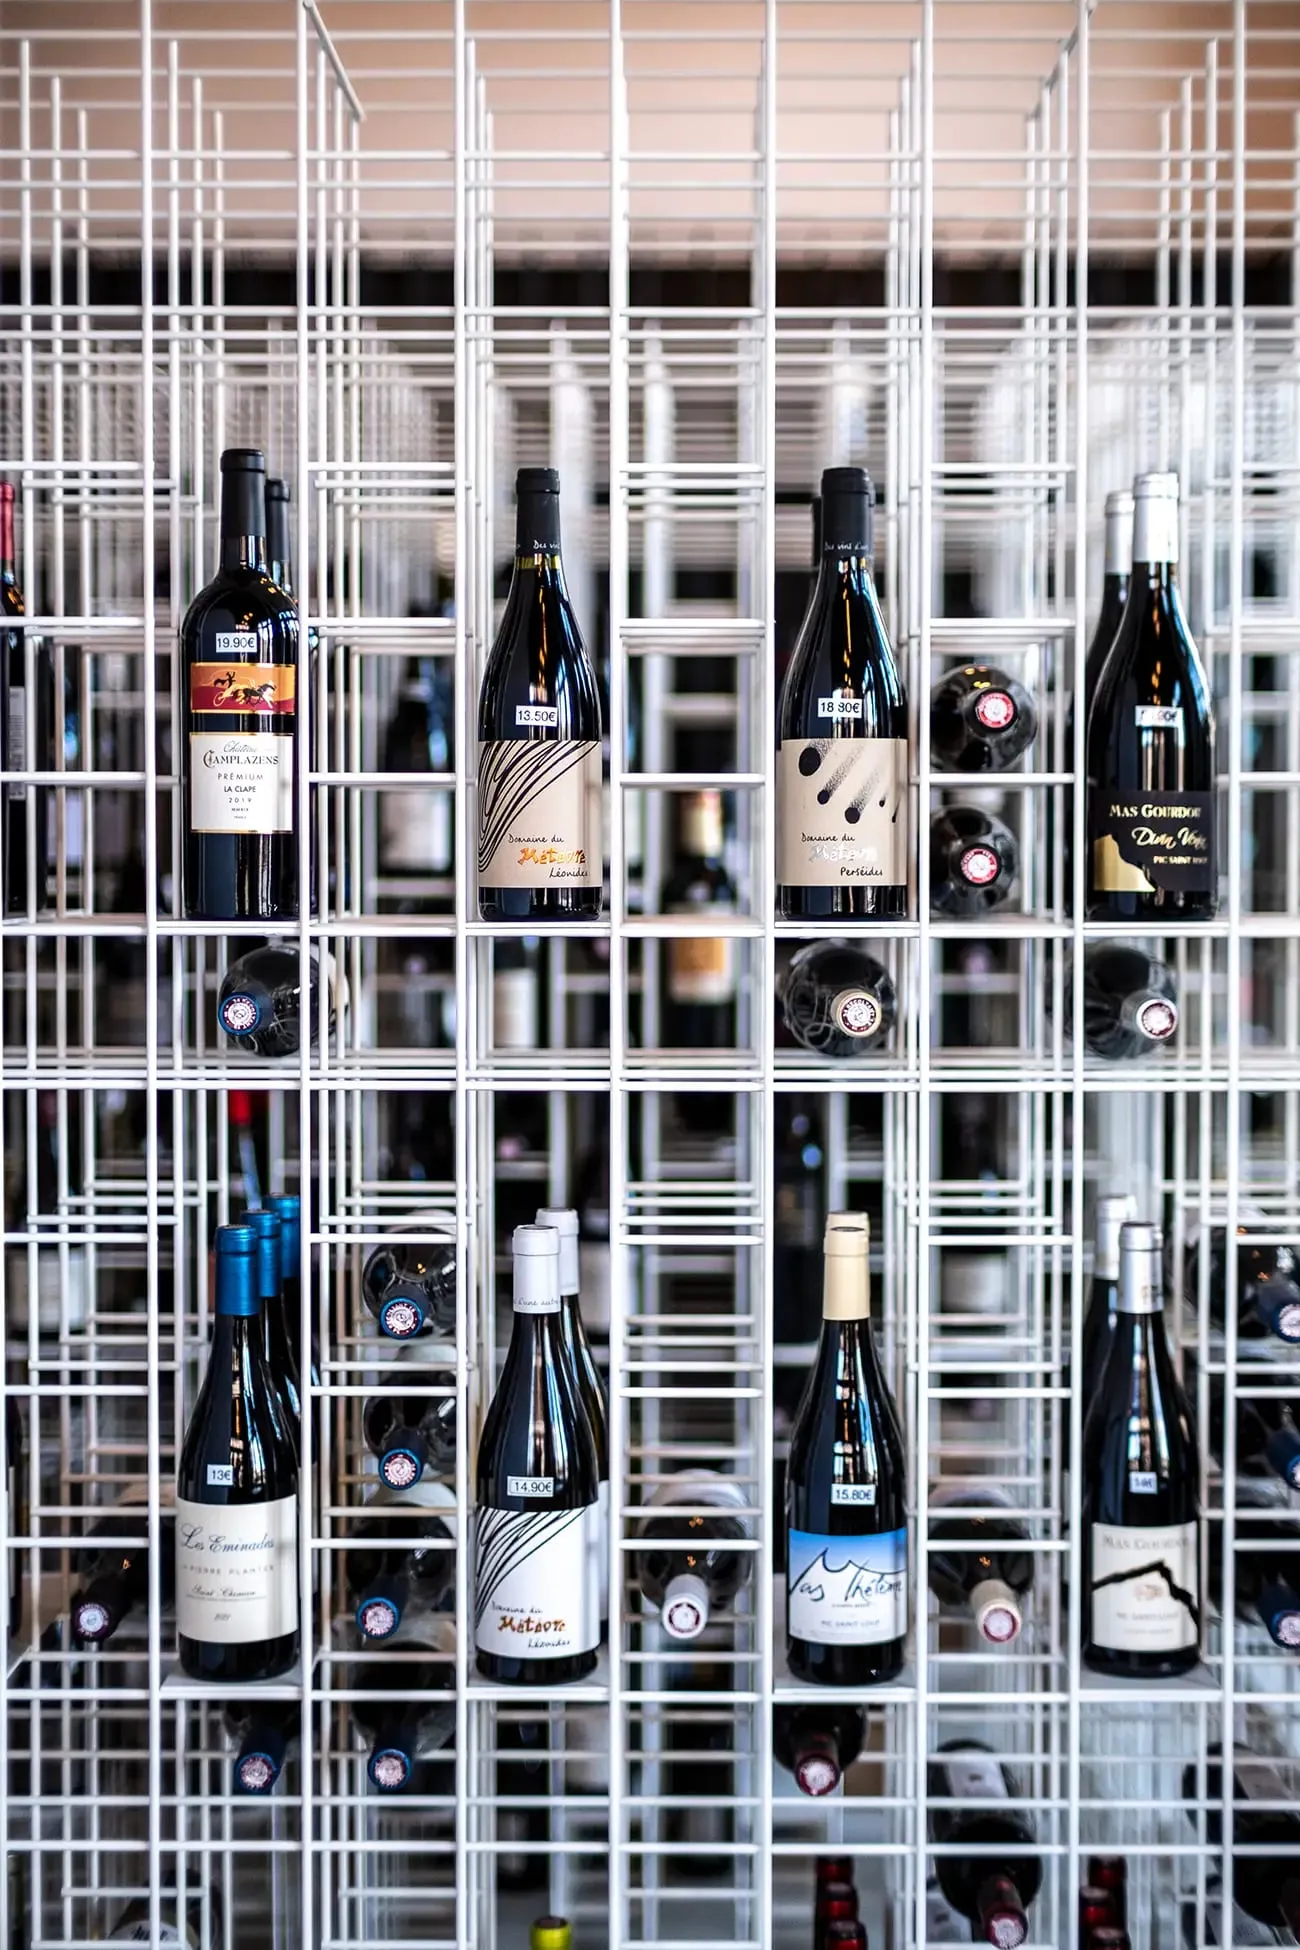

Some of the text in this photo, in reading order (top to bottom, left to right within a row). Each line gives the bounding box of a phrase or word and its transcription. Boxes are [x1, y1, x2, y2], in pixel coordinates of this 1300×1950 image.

[217, 636, 256, 649] 19.90€
[820, 701, 860, 714] 1880€
[518, 709, 557, 723] 13.50€
[223, 785, 256, 793] LA CLAPE
[228, 796, 253, 804] 2019
[1109, 804, 1139, 818] MAS
[508, 833, 565, 844] Domaine du
[800, 832, 856, 843] Domaine du
[211, 1469, 231, 1481] 13€
[514, 1480, 553, 1493] 14.90€
[835, 1489, 873, 1500] 15.80€
